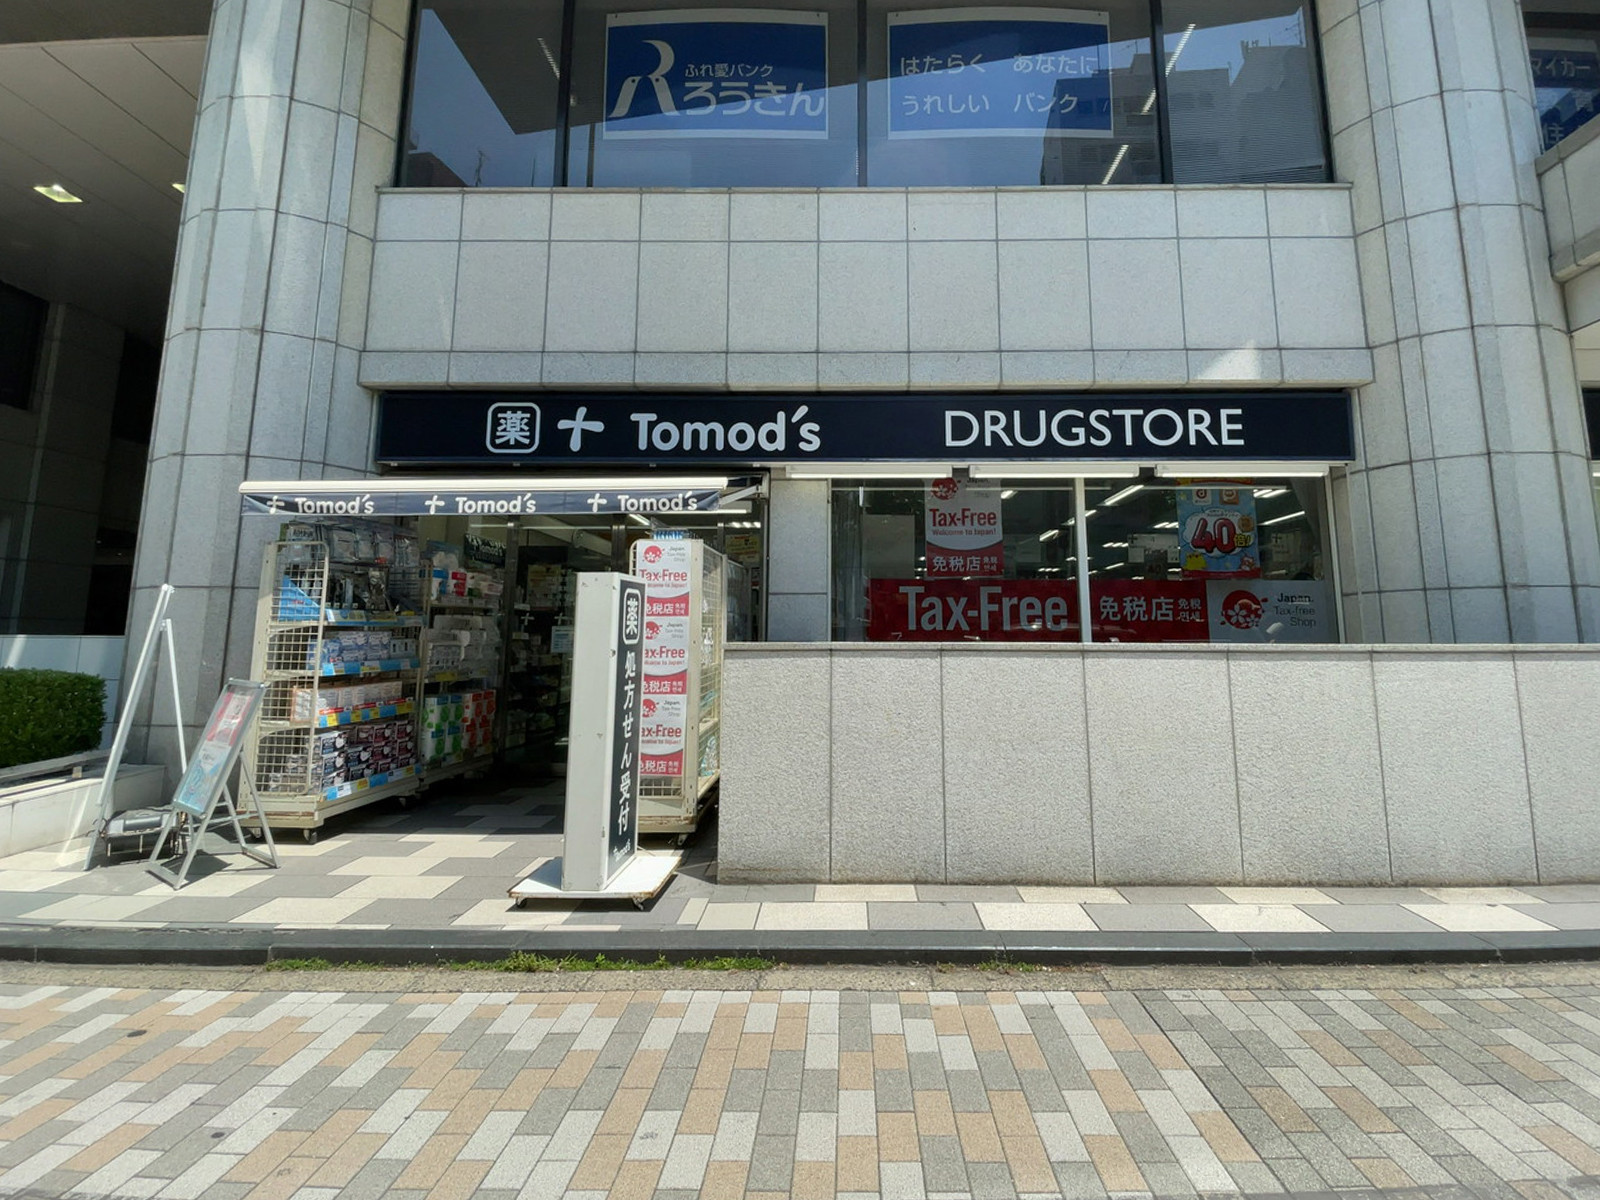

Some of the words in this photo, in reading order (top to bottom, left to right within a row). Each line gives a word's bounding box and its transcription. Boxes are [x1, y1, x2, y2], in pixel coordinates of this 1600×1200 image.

[684, 63, 774, 78] ふれ愛バンク
[901, 54, 986, 74] はたらく
[1012, 53, 1099, 75] あなたに
[682, 81, 825, 117] ろうきん
[901, 95, 990, 116] うれしい
[1013, 94, 1078, 114] バンク
[494, 410, 531, 446] 薬
[629, 405, 822, 453] Tomod's
[944, 408, 1246, 448] DRUGSTORE
[294, 494, 375, 515] Tomod's
[454, 492, 537, 514] Tomod's
[616, 491, 698, 512] Tomod's
[928, 507, 998, 528] Tax-Free
[639, 568, 688, 581] Tax-Free
[932, 555, 981, 572] 免税店
[625, 597, 639, 635] 薬
[899, 585, 1069, 632] Tax-Free
[1100, 595, 1175, 622] 免税店
[1289, 616, 1317, 628] Shop
[644, 645, 686, 658] ax-Free
[641, 724, 682, 738] ax-Free
[617, 650, 636, 836] 処方せん受付
